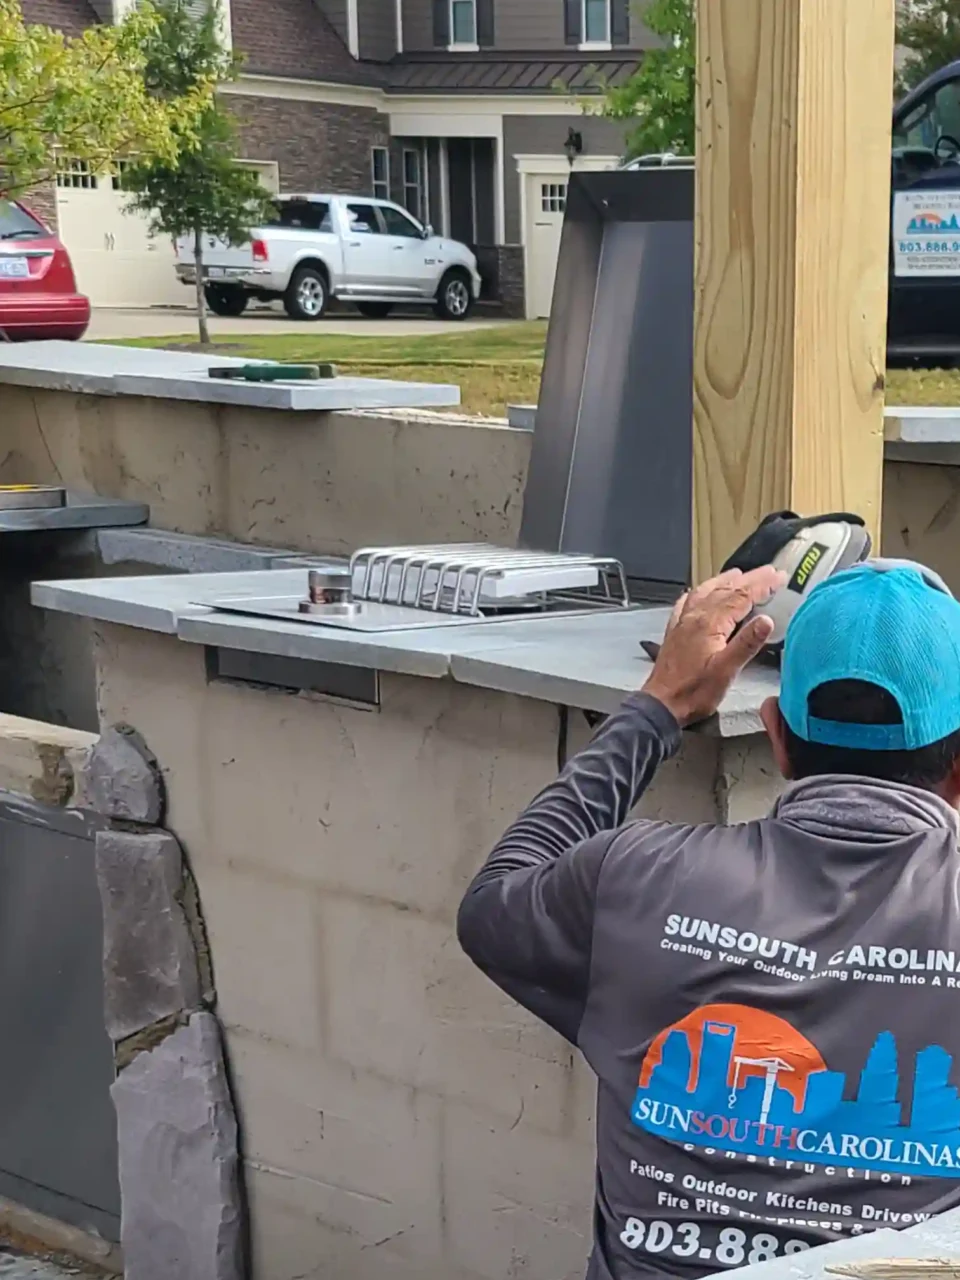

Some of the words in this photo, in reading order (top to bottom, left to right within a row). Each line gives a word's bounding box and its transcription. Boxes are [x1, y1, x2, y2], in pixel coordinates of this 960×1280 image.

[660, 938, 712, 960] Creating
[718, 951, 748, 966] Your
[753, 960, 806, 982] Outdoor
[853, 969, 895, 984] Dream
[899, 974, 926, 985] Into
[931, 976, 942, 986] A
[664, 914, 817, 971] SUNSOUTH
[683, 1143, 912, 1186] construction
[630, 1160, 675, 1183] Patios
[682, 1174, 758, 1202] Outdoor
[766, 1191, 853, 1216] Kitchens
[861, 1204, 939, 1222] Drivew
[657, 1191, 689, 1209] Fire
[695, 1198, 731, 1216] Pits
